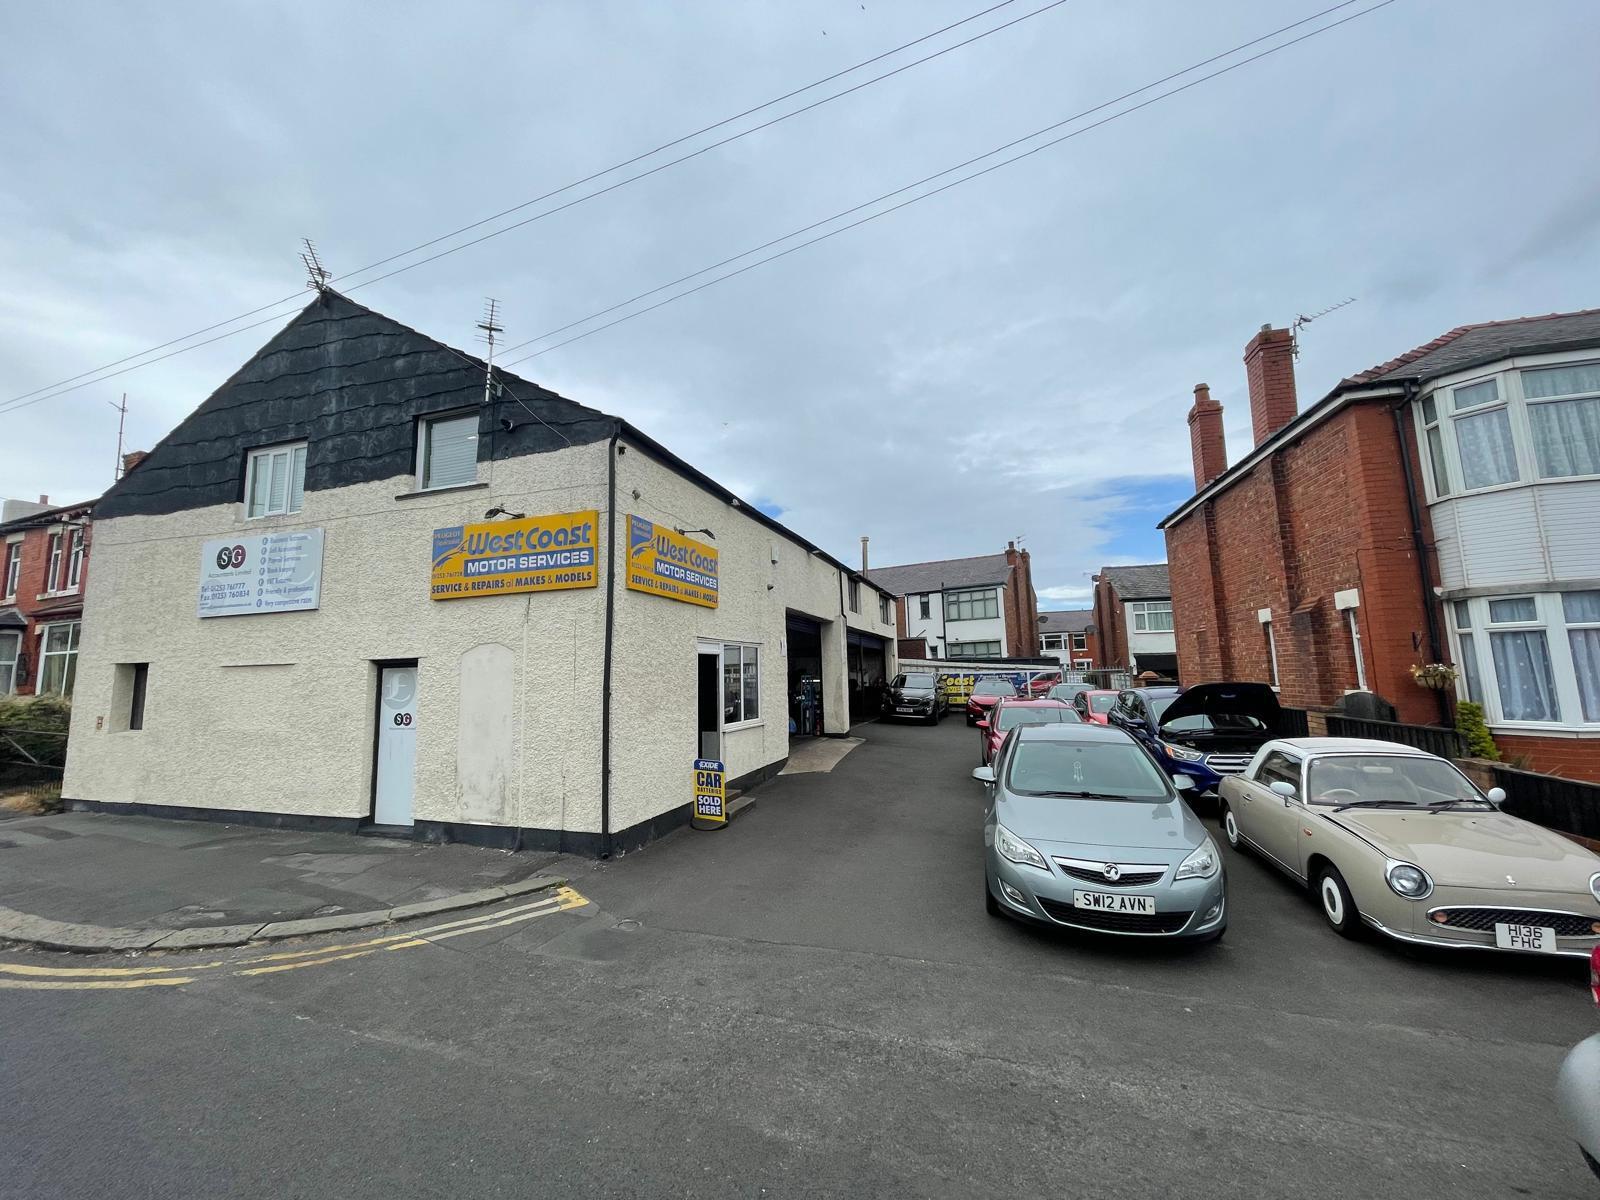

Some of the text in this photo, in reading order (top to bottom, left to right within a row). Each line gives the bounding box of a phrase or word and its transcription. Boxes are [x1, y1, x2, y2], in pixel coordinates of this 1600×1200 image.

[468, 522, 592, 555] West Coast
[656, 534, 718, 574] West Coast
[467, 550, 590, 574] MOTOR SERVICES
[431, 582, 462, 593] SERVICE
[463, 582, 469, 591] &
[471, 579, 505, 591] REPAIRS
[515, 576, 546, 587] MAKES
[555, 571, 592, 583] MODELS
[631, 574, 653, 588] SERVICE
[656, 561, 685, 579] MOTOR
[686, 570, 717, 589] SERVICES
[699, 761, 719, 769] EXIDE
[696, 772, 722, 788] CAR
[696, 787, 722, 795] BATTERIES
[697, 795, 721, 806] SOLD
[698, 805, 721, 815] HERE
[1083, 893, 1146, 911] SW12 AVN
[1507, 924, 1543, 938] H136
[1510, 935, 1542, 949] FHG
